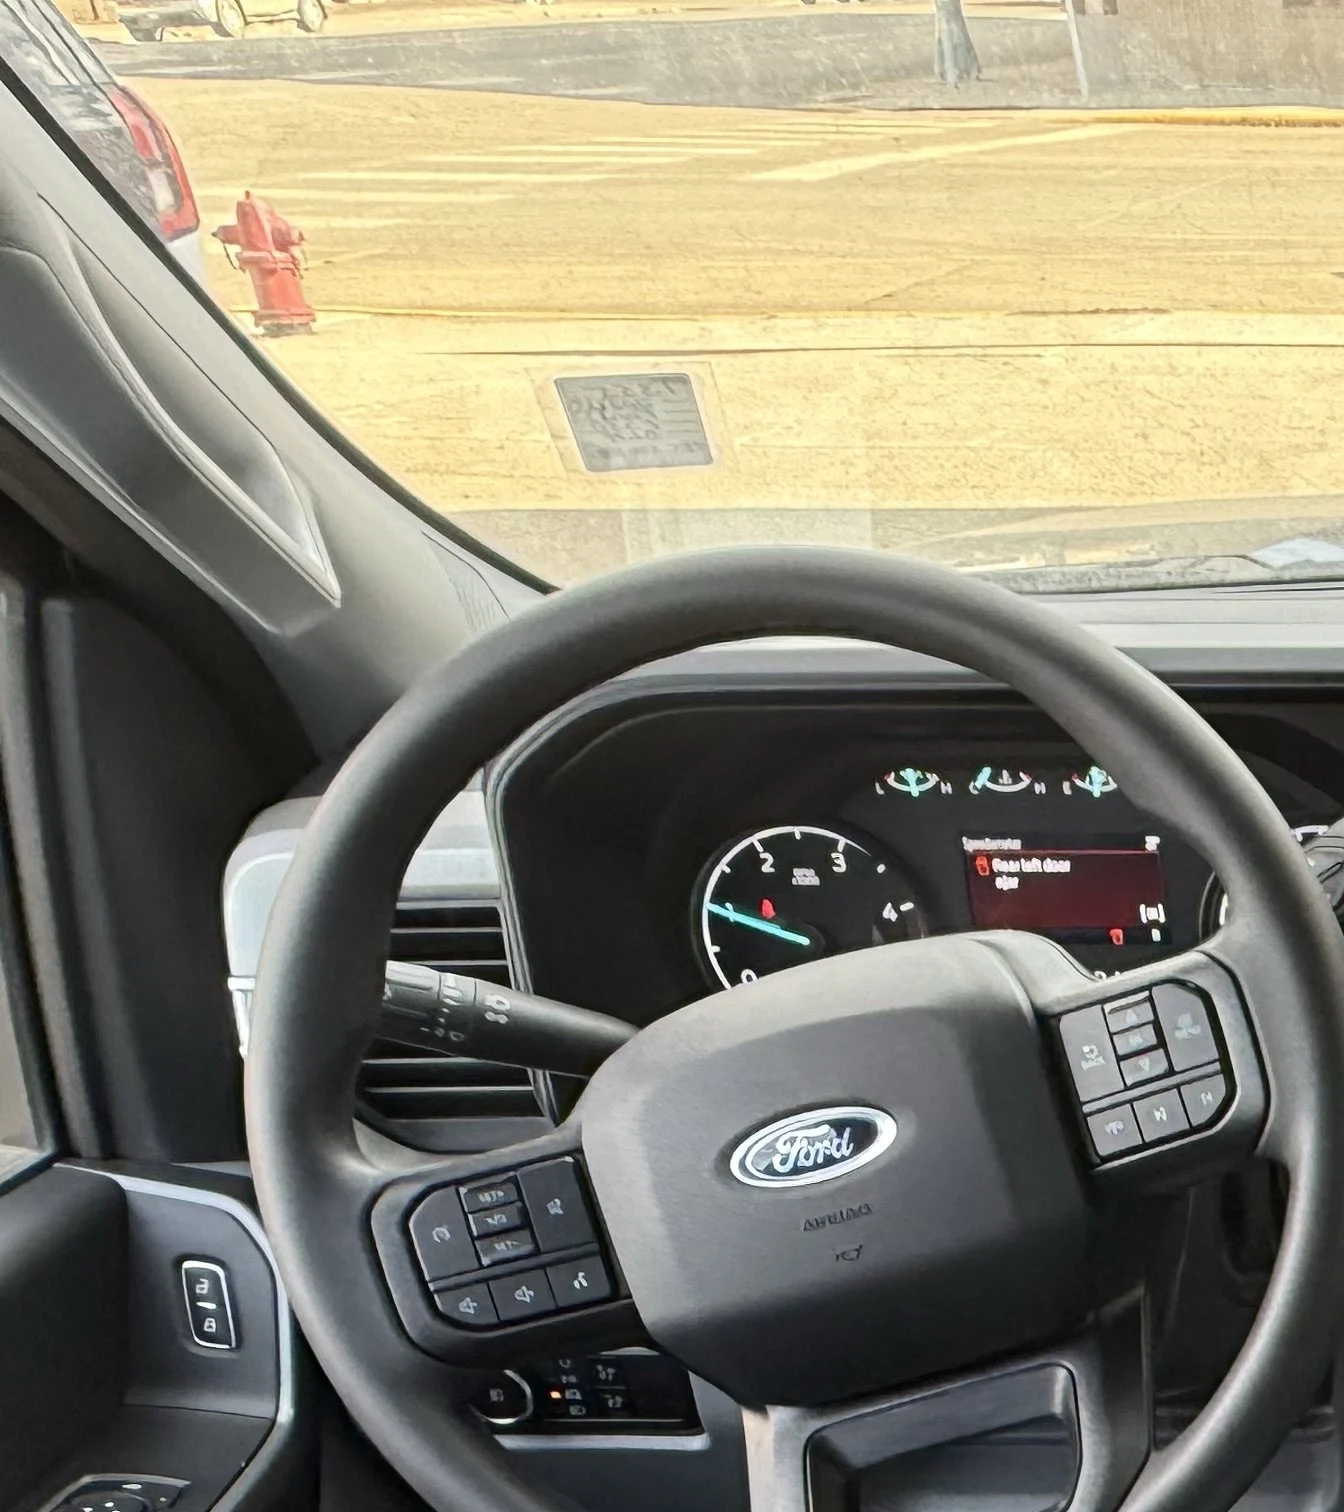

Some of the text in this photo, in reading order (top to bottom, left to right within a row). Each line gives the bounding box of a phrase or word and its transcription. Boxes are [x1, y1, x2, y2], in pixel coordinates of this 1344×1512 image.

[759, 852, 776, 873] 2
[831, 852, 847, 873] 3
[882, 902, 899, 923] 4
[771, 1124, 854, 1174] Ford
